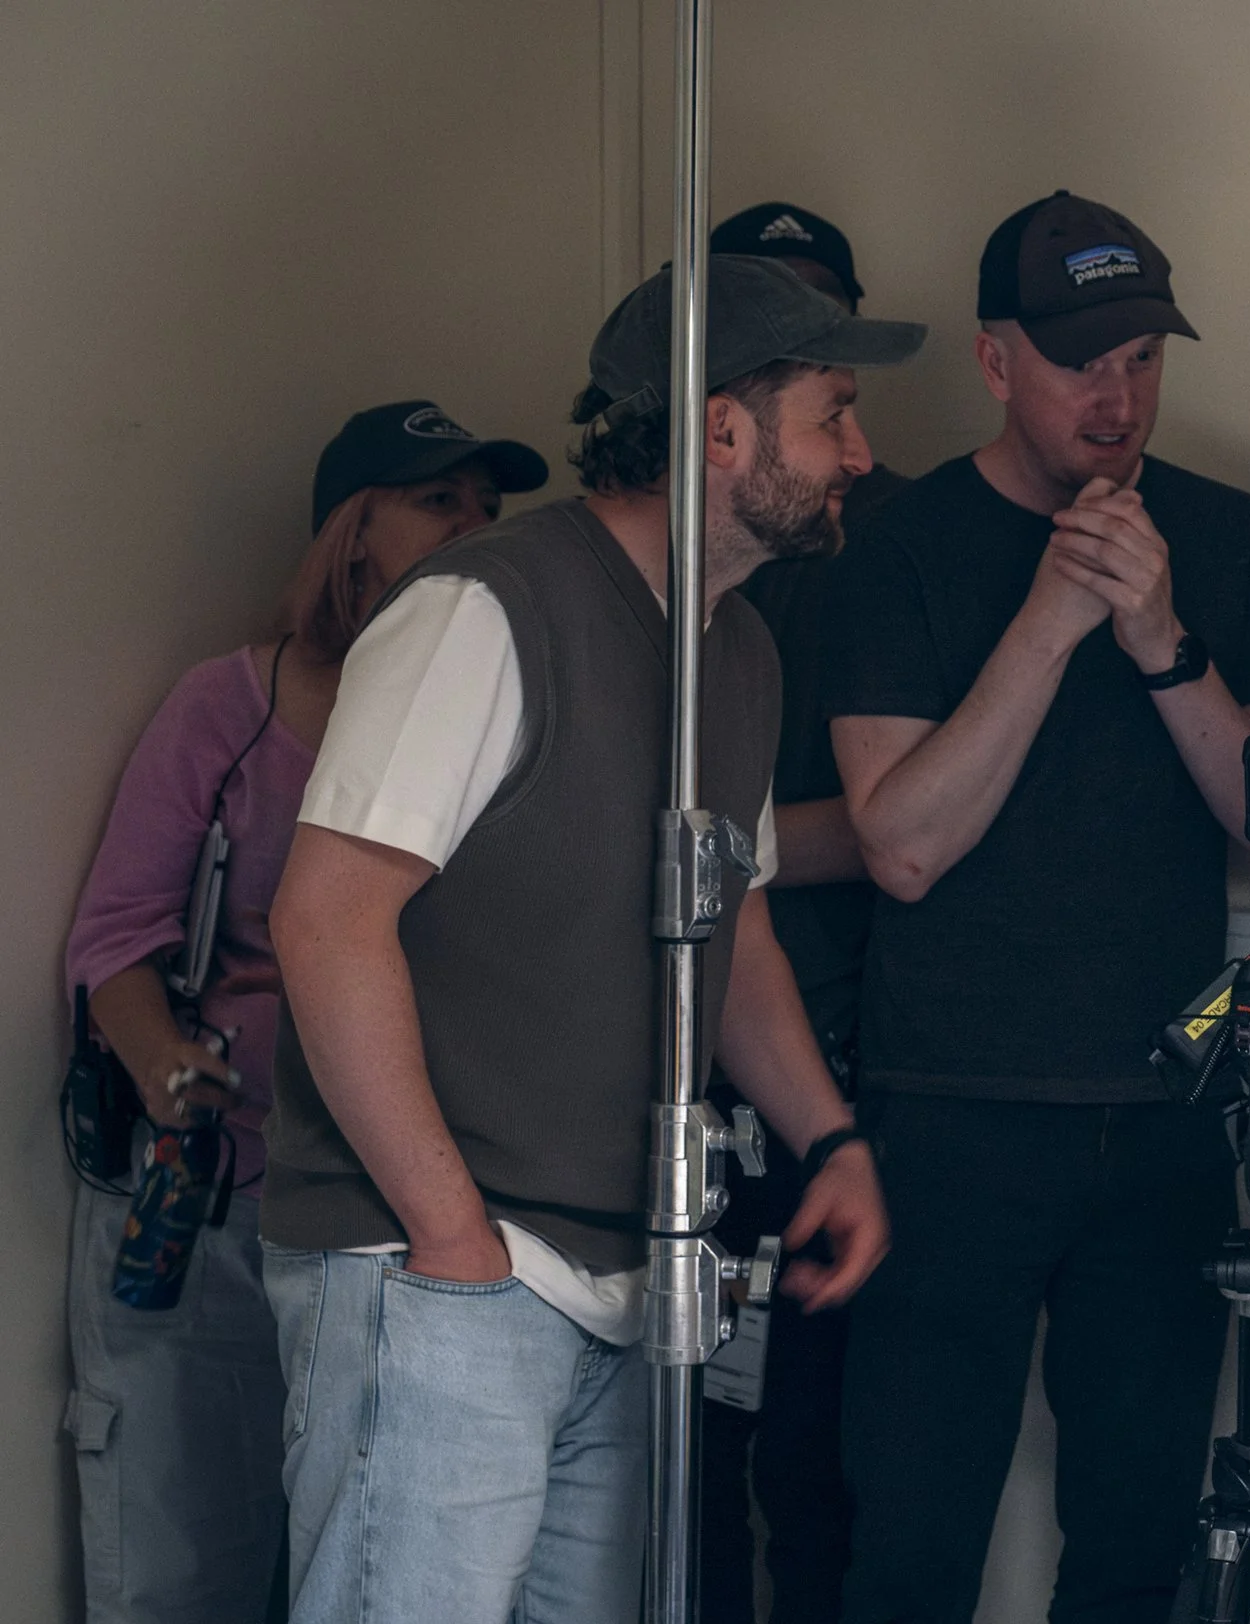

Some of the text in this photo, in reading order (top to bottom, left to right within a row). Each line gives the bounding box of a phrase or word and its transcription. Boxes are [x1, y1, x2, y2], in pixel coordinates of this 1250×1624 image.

[1074, 263, 1140, 286] patagonia
[1202, 994, 1231, 1023] RCAD
[1192, 1021, 1204, 1033] 04
